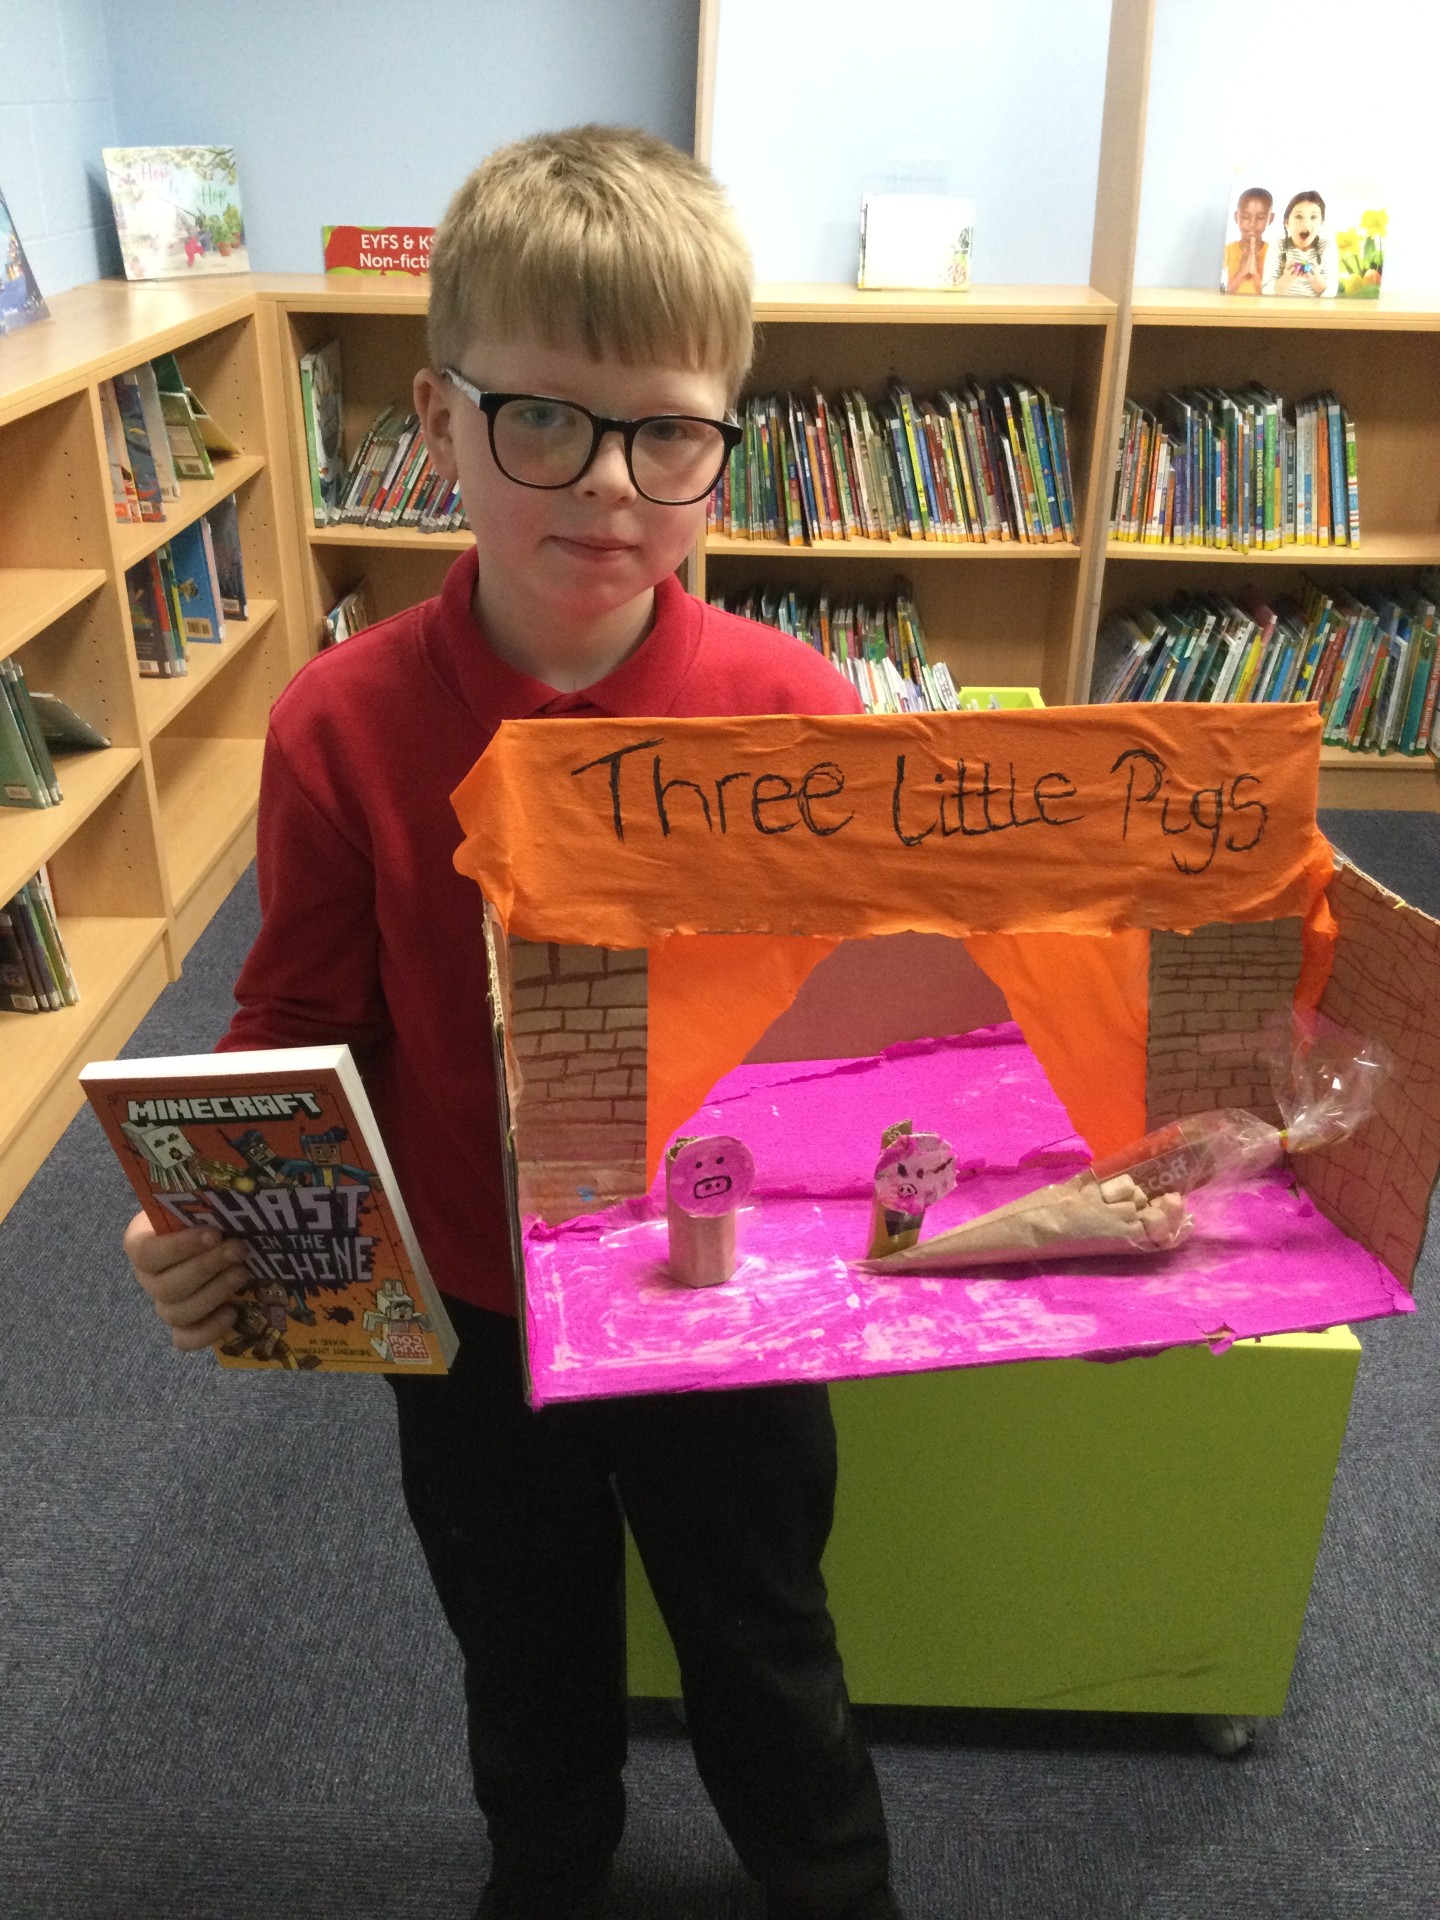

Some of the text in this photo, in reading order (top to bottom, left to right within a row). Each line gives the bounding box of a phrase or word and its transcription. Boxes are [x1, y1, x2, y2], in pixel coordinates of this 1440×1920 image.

[199, 184, 226, 208] Hop
[361, 234, 399, 249] EYFS
[403, 235, 414, 249] &
[359, 252, 429, 268] Non-ficti
[571, 738, 1268, 875] Three Little Pigs
[127, 1092, 322, 1121] MINECRAFT
[256, 1234, 326, 1250] IN THE
[245, 1236, 374, 1280] ACHINE
